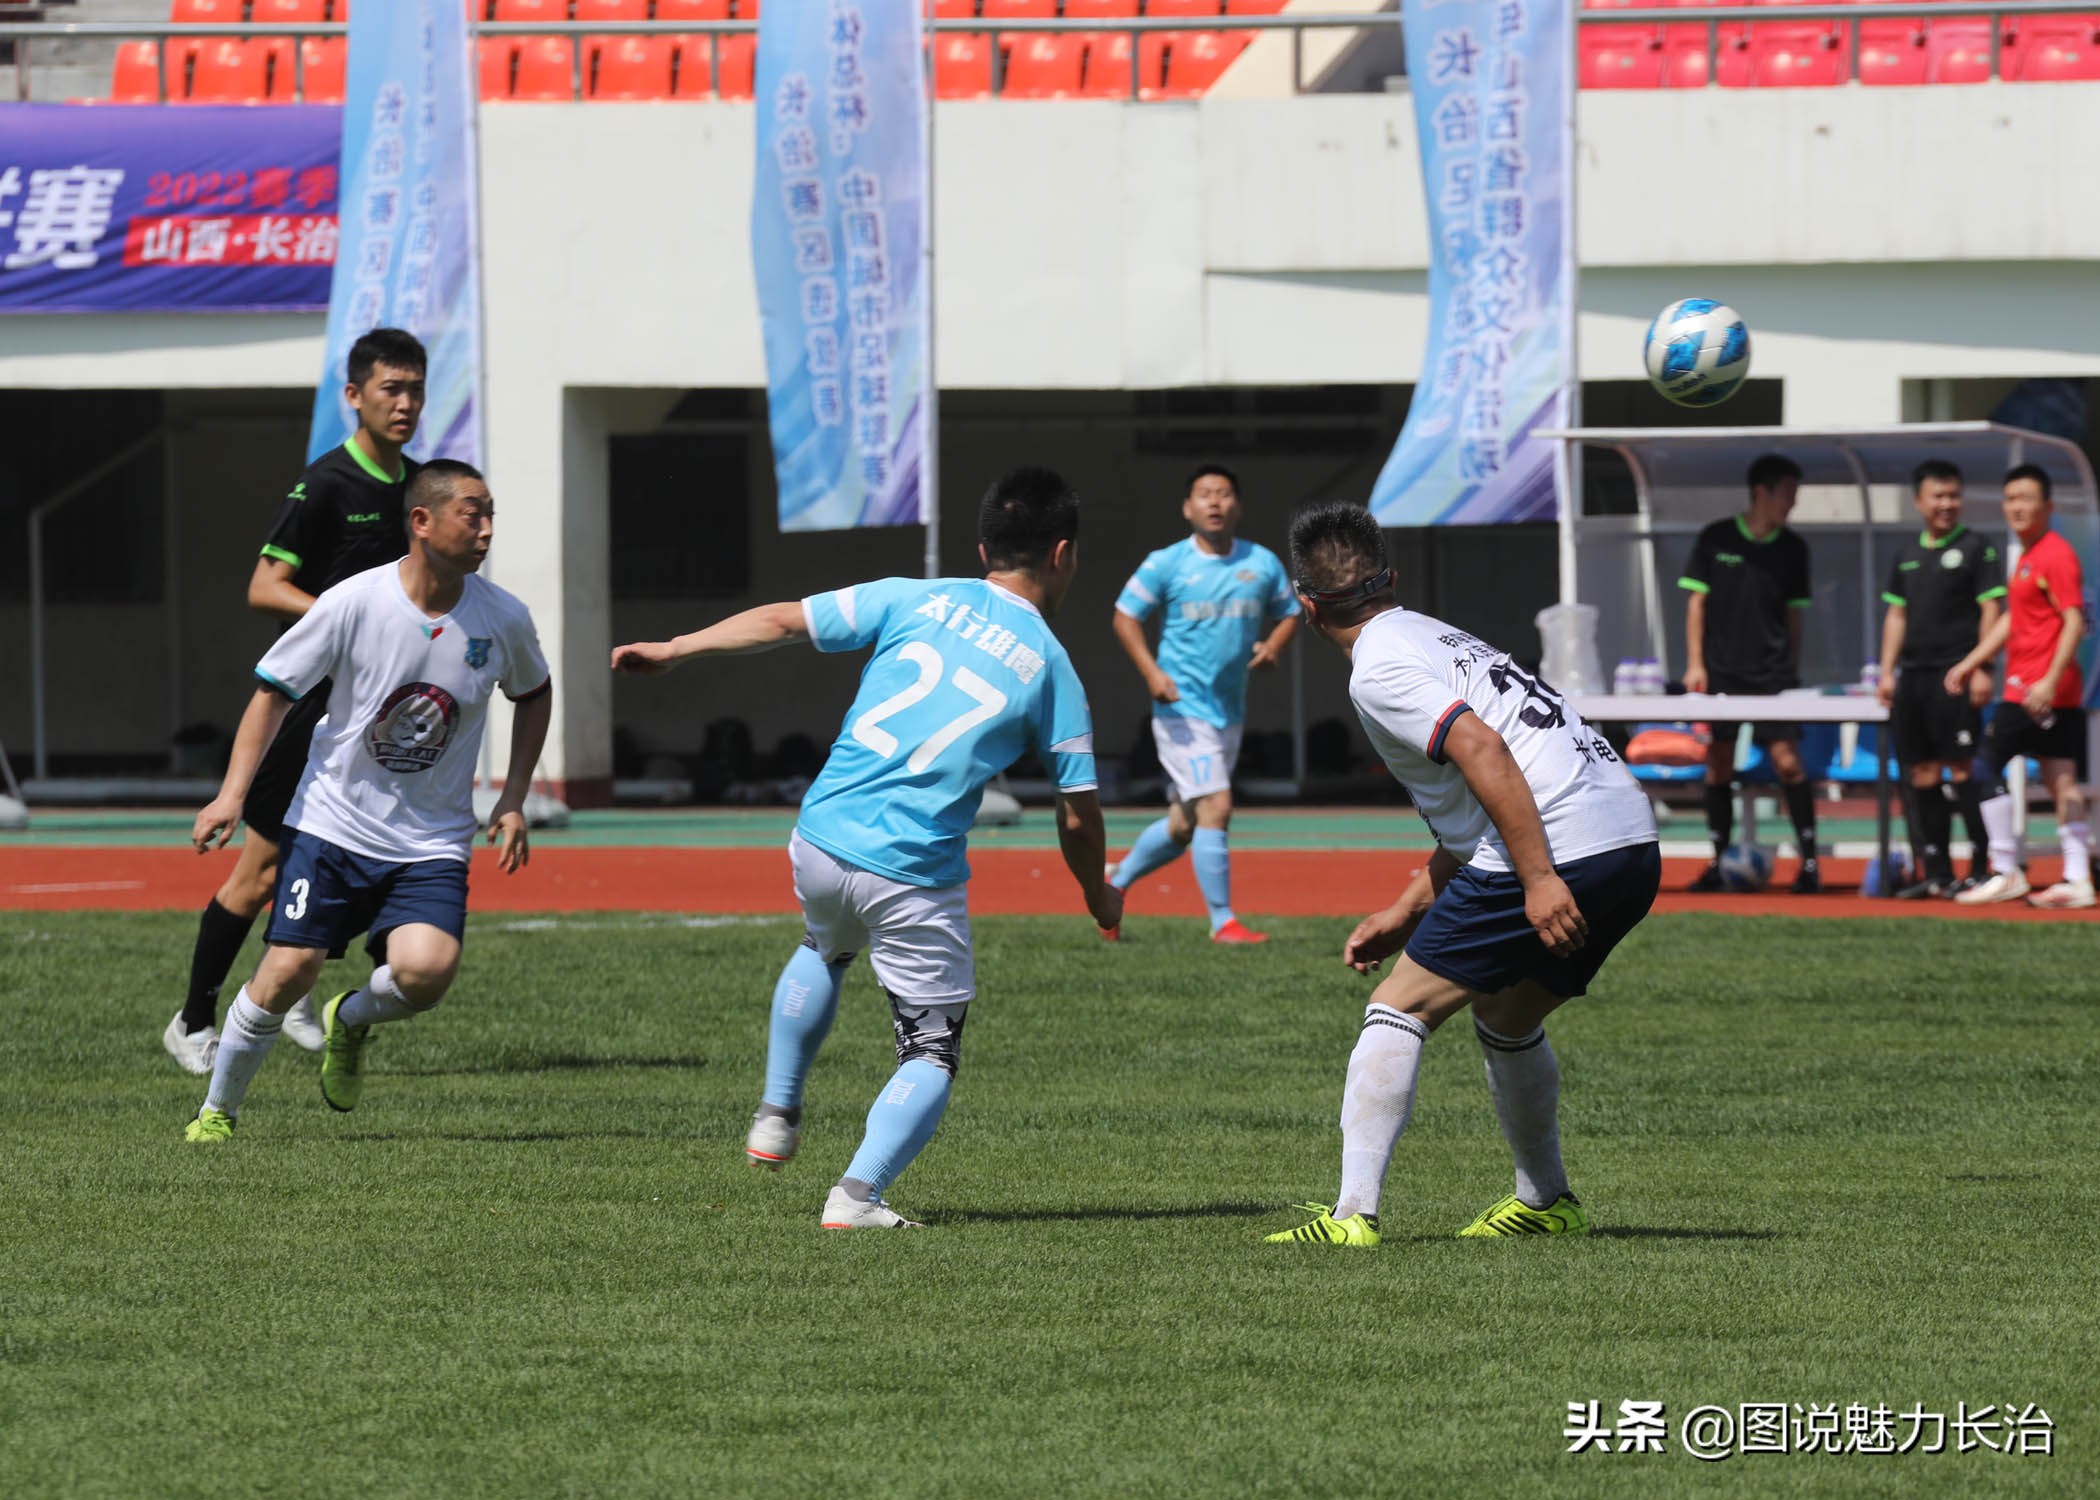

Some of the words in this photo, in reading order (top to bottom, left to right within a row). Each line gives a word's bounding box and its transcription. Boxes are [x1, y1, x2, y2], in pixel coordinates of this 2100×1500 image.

[914, 592, 1046, 686] 太行雄鹰
[852, 640, 1009, 775] 27
[1187, 753, 1212, 785] 17
[285, 877, 310, 921] 3
